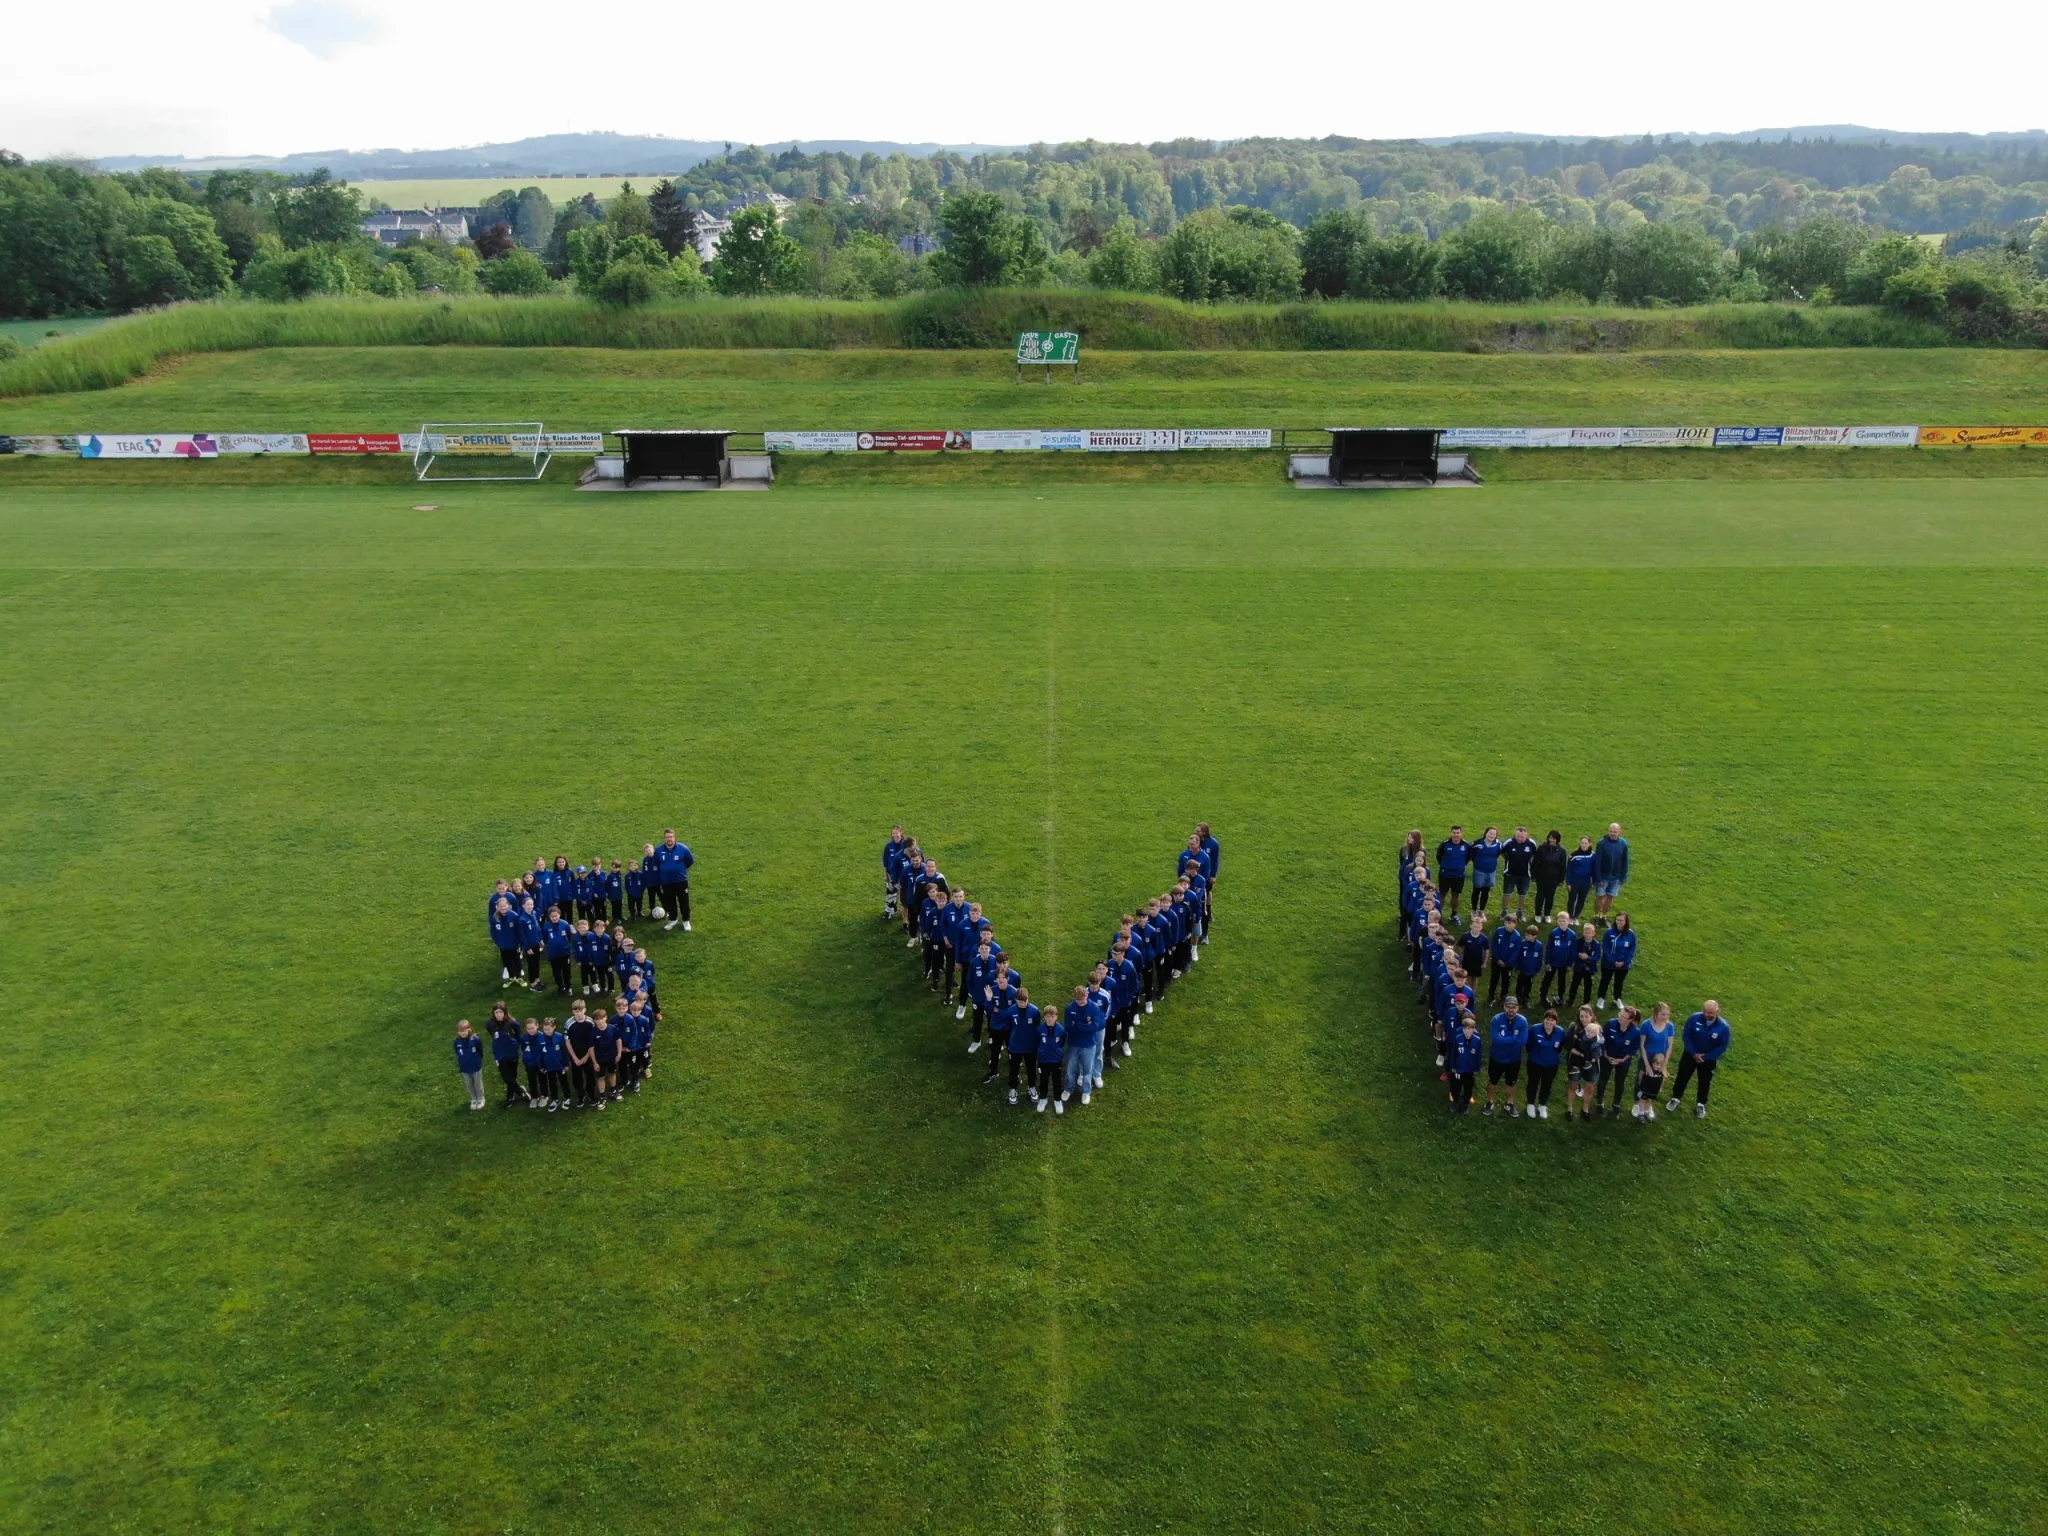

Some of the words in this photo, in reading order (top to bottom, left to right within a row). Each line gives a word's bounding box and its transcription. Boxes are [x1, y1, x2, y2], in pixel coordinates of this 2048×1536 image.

[1458, 429, 1512, 437] Dienstleistungen
[1676, 428, 1708, 438] HOH
[1717, 428, 1744, 436] Allianz
[1785, 427, 1838, 435] Blitzschutzbau
[1952, 427, 2022, 443] Sonnenbräu
[463, 435, 510, 445] PERTHEL
[1051, 434, 1082, 443] sumida
[1090, 437, 1142, 446] HERHOLZ
[116, 442, 144, 451] TEAG
